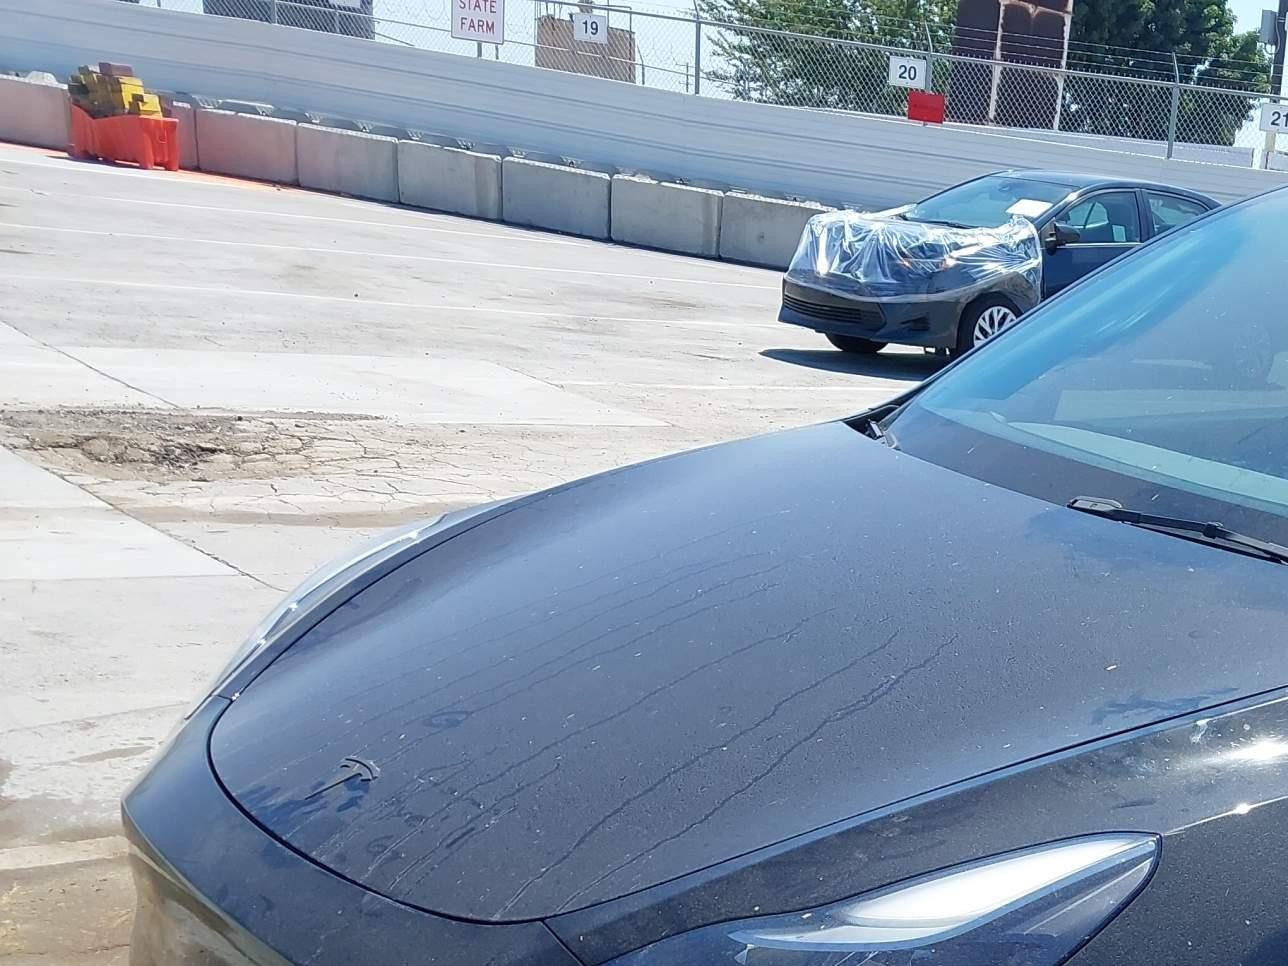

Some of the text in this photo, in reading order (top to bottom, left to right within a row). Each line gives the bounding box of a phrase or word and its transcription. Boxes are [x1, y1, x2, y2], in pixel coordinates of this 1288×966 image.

[459, 0, 497, 14] STATE
[460, 17, 495, 35] FARM
[582, 20, 599, 36] 19
[898, 64, 917, 81] 20
